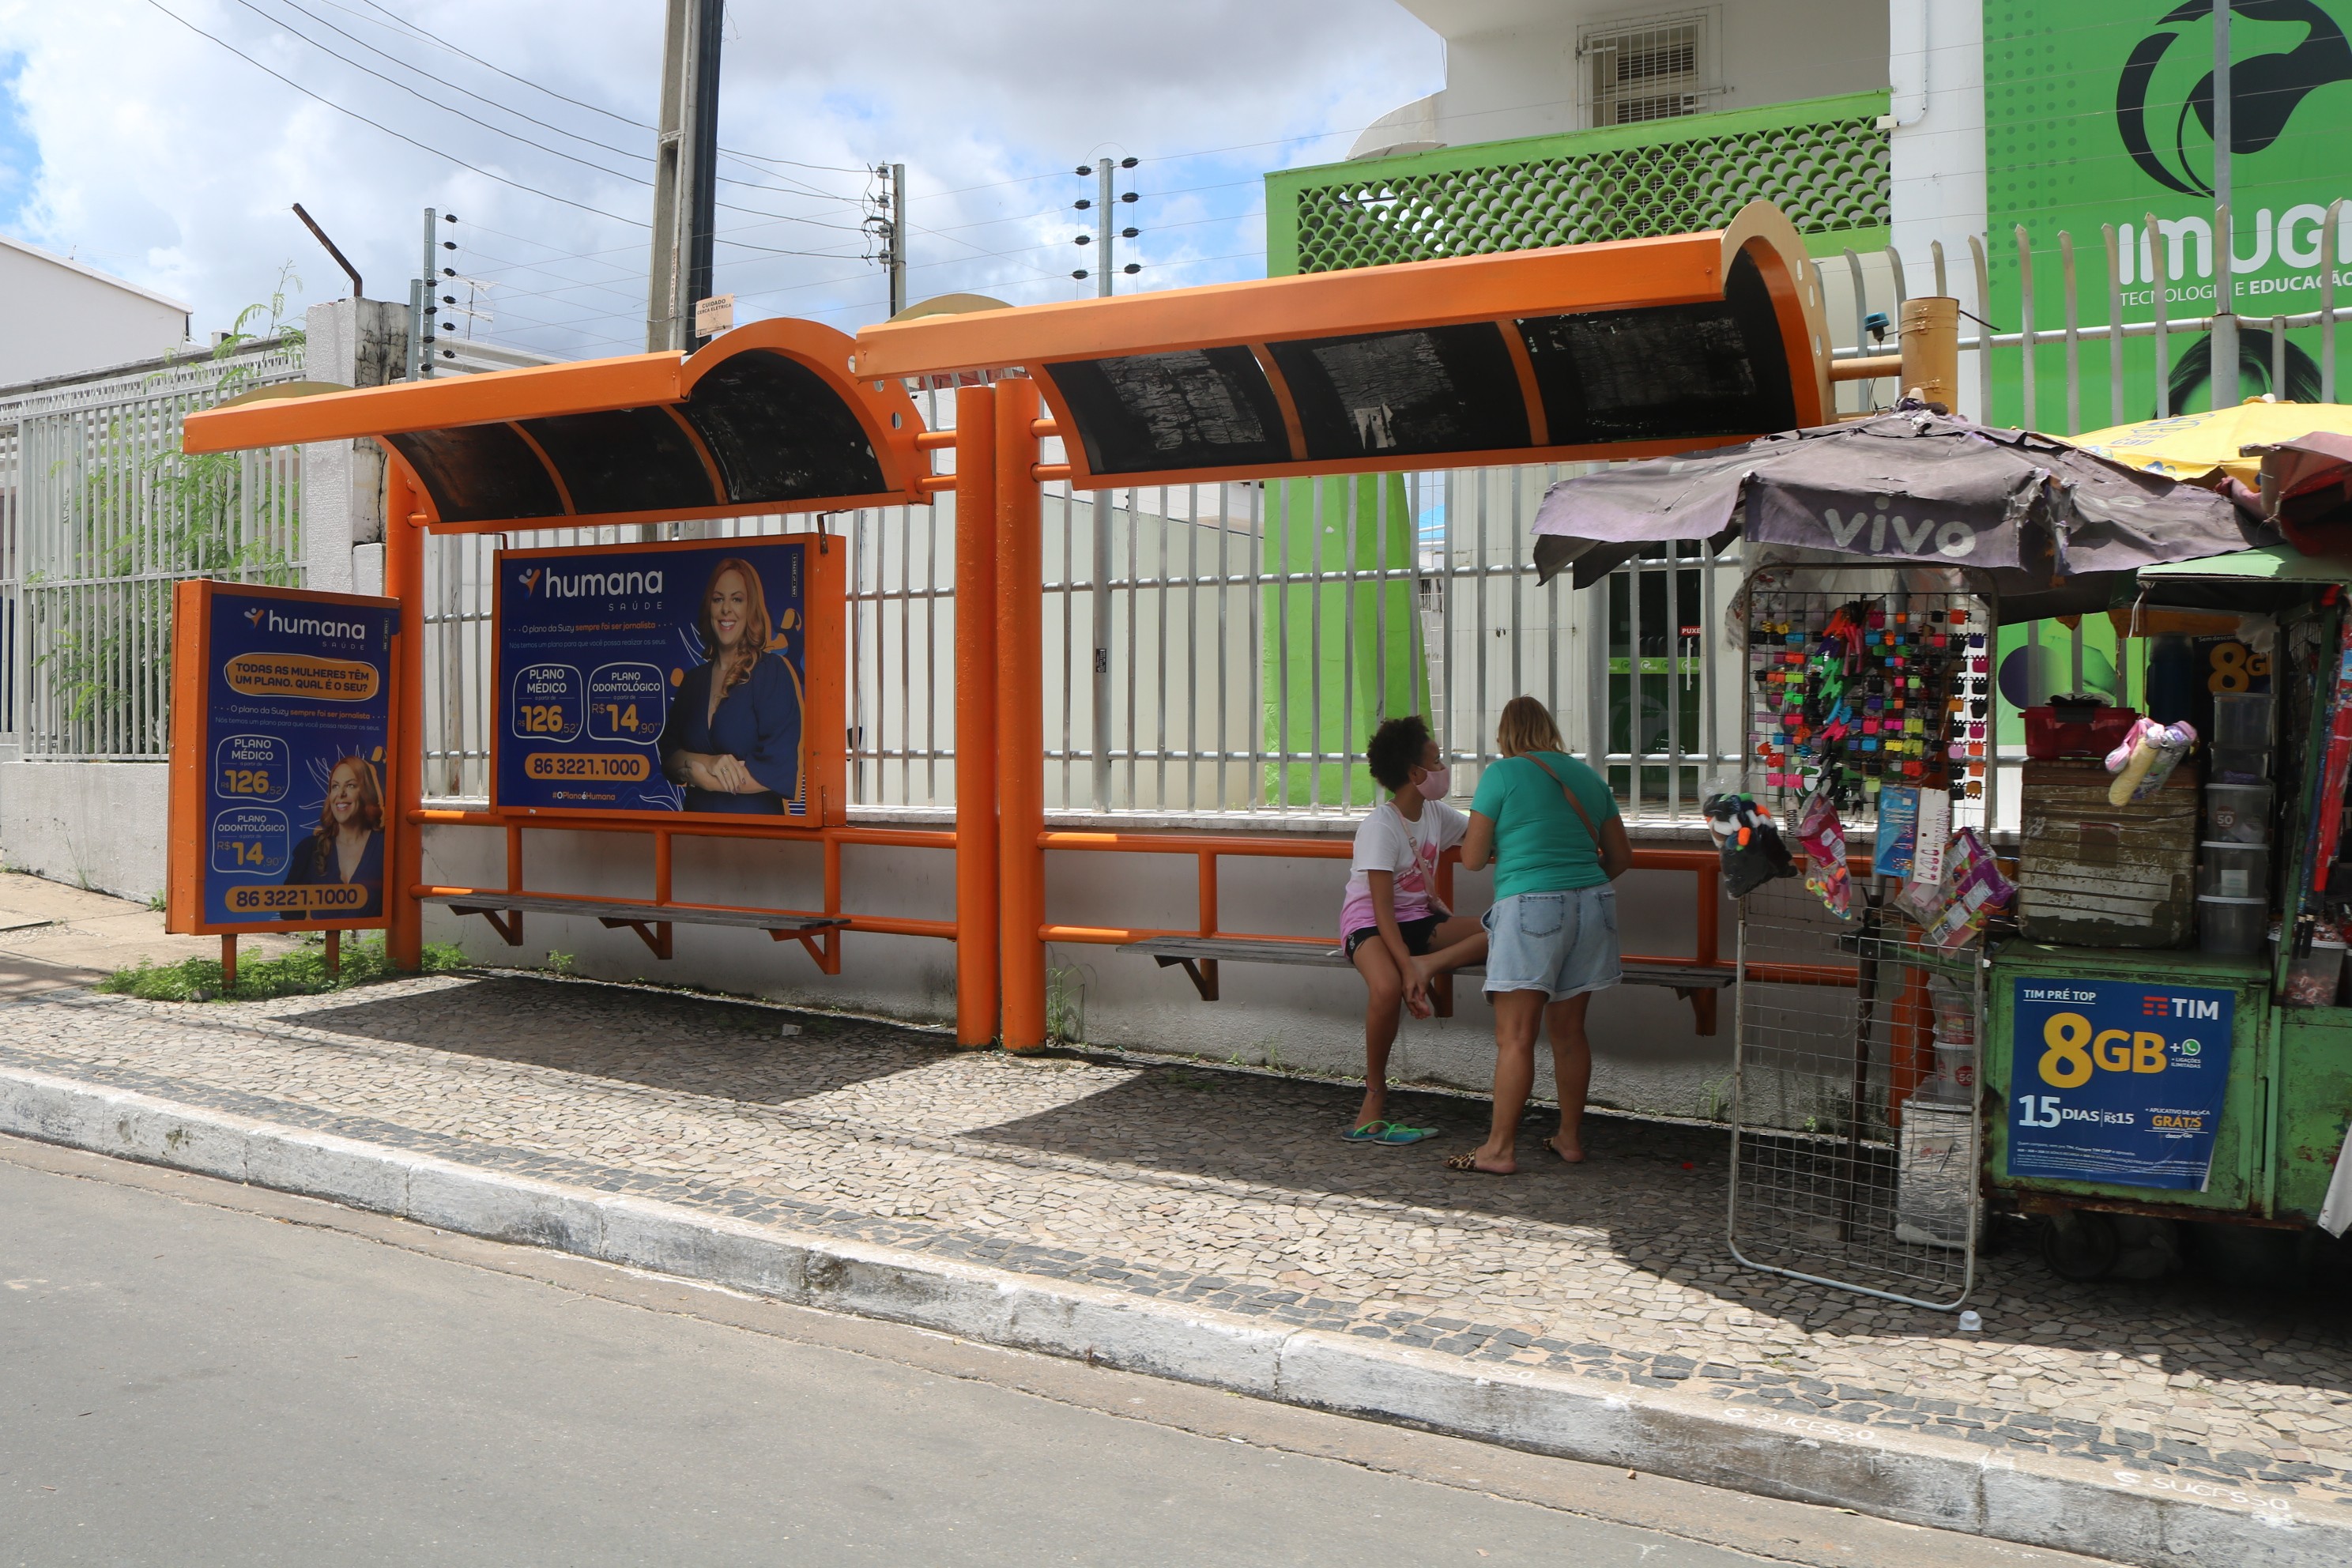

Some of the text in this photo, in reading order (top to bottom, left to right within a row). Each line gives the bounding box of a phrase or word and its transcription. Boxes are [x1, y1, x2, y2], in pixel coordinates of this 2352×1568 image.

[2236, 282, 2244, 296] E
[702, 299, 726, 308] CUIDADO
[711, 303, 731, 311] ELÉTRICA
[1824, 496, 1975, 558] vivo
[546, 567, 663, 598] humana
[609, 601, 662, 611] SAÚDE
[269, 610, 366, 640] humana
[529, 625, 547, 634] plano
[558, 624, 574, 633] Suzy
[575, 624, 600, 632] sempre
[623, 621, 656, 631] jornalista
[322, 640, 365, 650] SAÚDE
[236, 663, 369, 681] TODAS AS MULHERES TÊM
[530, 669, 565, 679] PLANO
[612, 672, 640, 680] PLANO
[236, 676, 368, 692] UM PLANO. QUAL É O SEU?
[527, 680, 567, 693] MÉDICO
[593, 680, 660, 692] ODONTOLÓGICO
[238, 706, 259, 714] plano
[271, 707, 289, 717] Suzy
[290, 710, 315, 718] sempre
[339, 711, 370, 719] jornalista
[234, 739, 272, 749] PLANO
[231, 749, 274, 760] MÉDICO
[534, 758, 640, 776] 86 3221.1000
[552, 792, 615, 800] #OPlanoéHumana
[2217, 815, 2233, 825] 50
[218, 823, 285, 832] ODONTOLÓGICO
[237, 889, 357, 907] 86 3221.1000
[2024, 988, 2096, 1001] TIM PRÉ TOP
[2172, 998, 2219, 1020] TIM
[2038, 1012, 2167, 1088] 8GB
[2018, 1095, 2100, 1128] 15 DIAS
